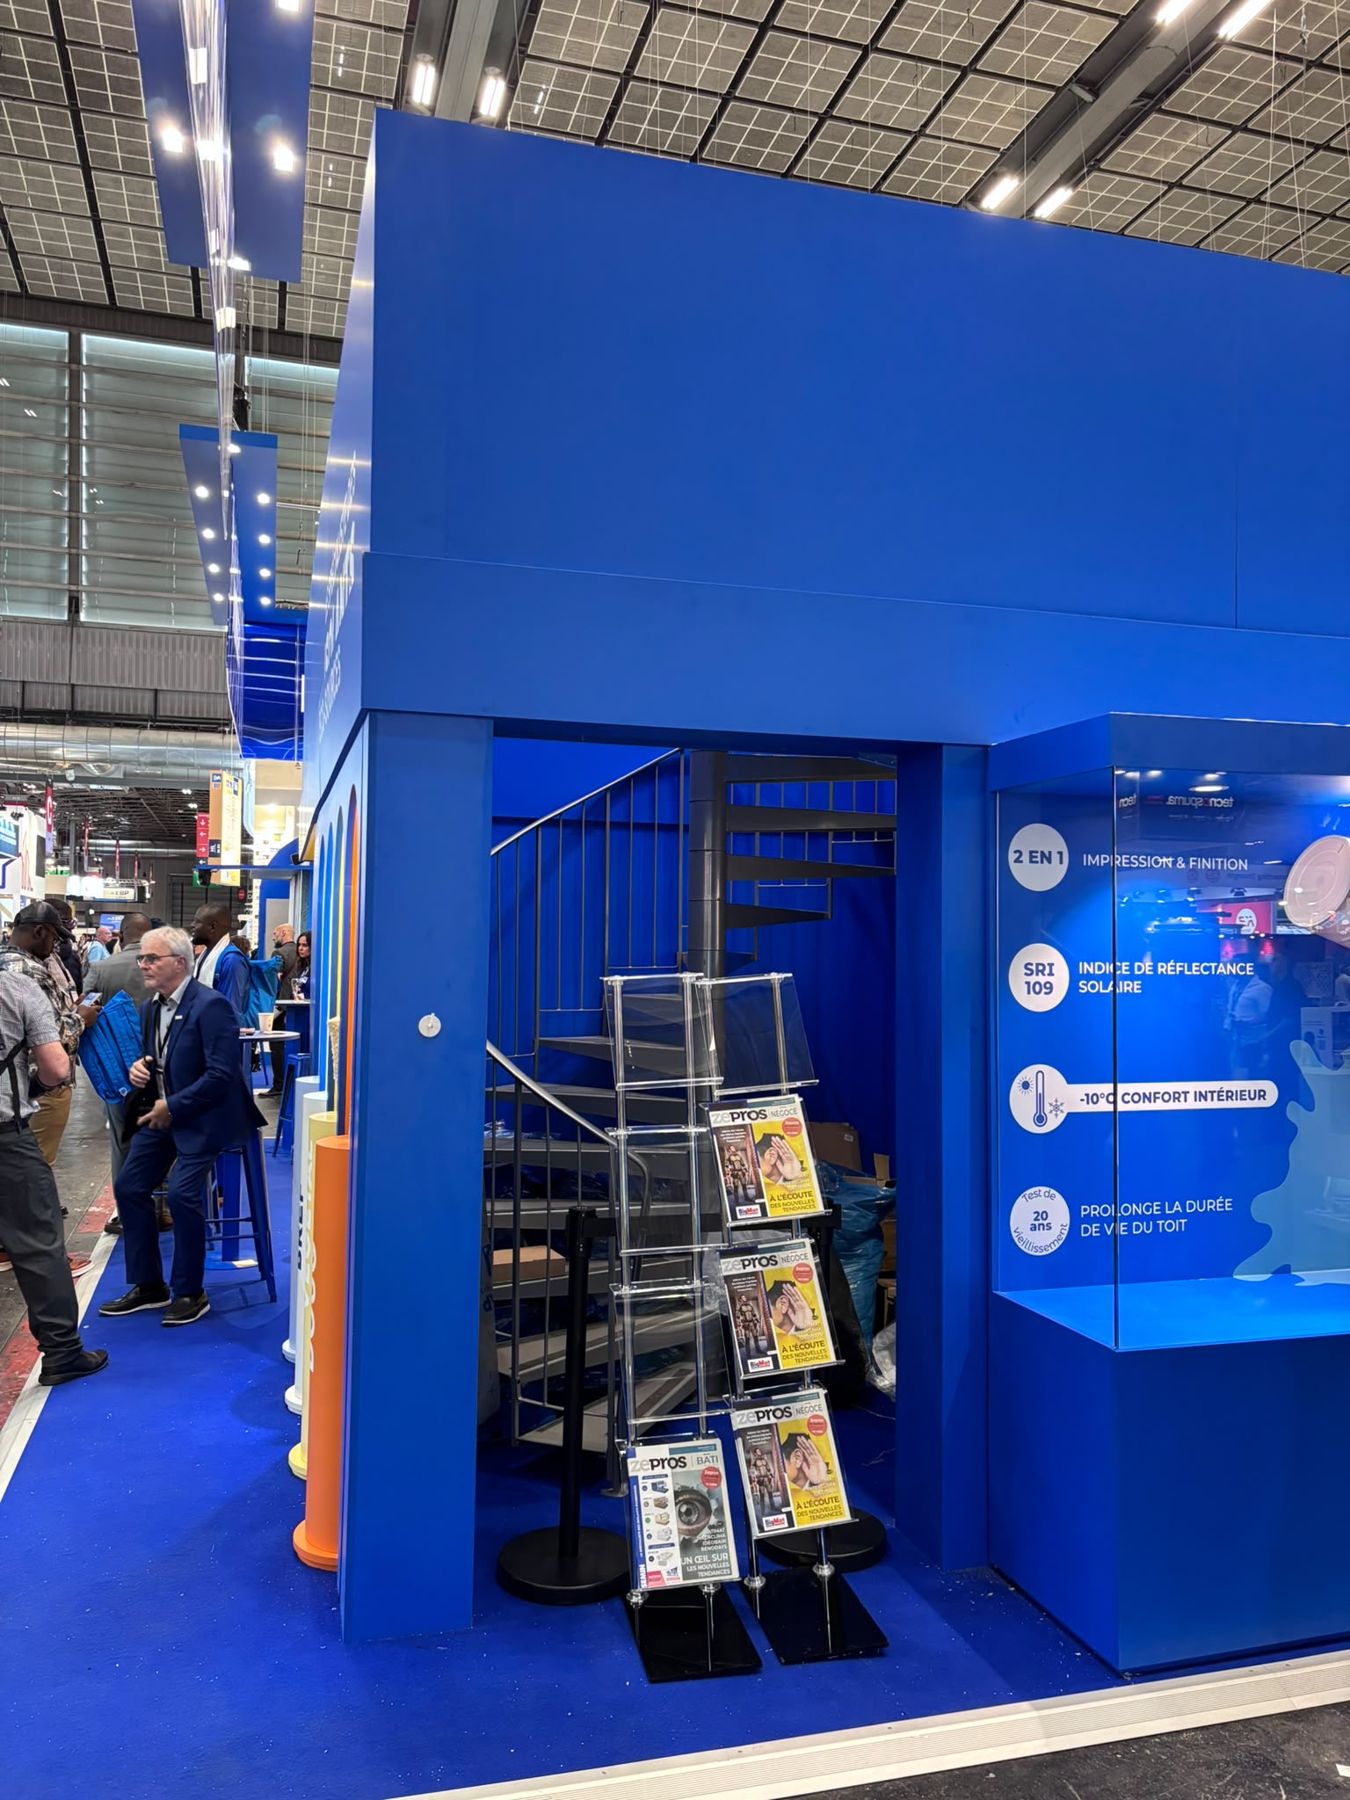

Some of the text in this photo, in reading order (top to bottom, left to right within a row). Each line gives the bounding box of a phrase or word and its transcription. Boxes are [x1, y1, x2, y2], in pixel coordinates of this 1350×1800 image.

[1013, 850, 1064, 865] 2 EN 1
[1083, 853, 1248, 871] IMPRESSION & FINITION
[1023, 962, 1055, 977] SRI
[1079, 959, 1254, 975] INDICE DE RÉFLECTANCE
[1025, 981, 1053, 995] 109
[1078, 980, 1142, 994] SOLAIRE
[1080, 1087, 1267, 1105] -10°C CONFORT INTÉRIEUR
[1021, 1189, 1057, 1202] Test de
[782, 1199, 815, 1208] NOUVELLES
[1081, 1196, 1233, 1218] PROLONGE LA DURÉE
[1033, 1211, 1048, 1222] 20
[1029, 1222, 1052, 1232] ans
[1081, 1219, 1187, 1237] DE VIE DU TOIT
[1013, 1223, 1068, 1254] vieillissement
[794, 1348, 828, 1359] NOUVELLES
[809, 1505, 842, 1515] NOUVELLES
[681, 1556, 693, 1565] UN
[712, 1552, 729, 1562] SUR
